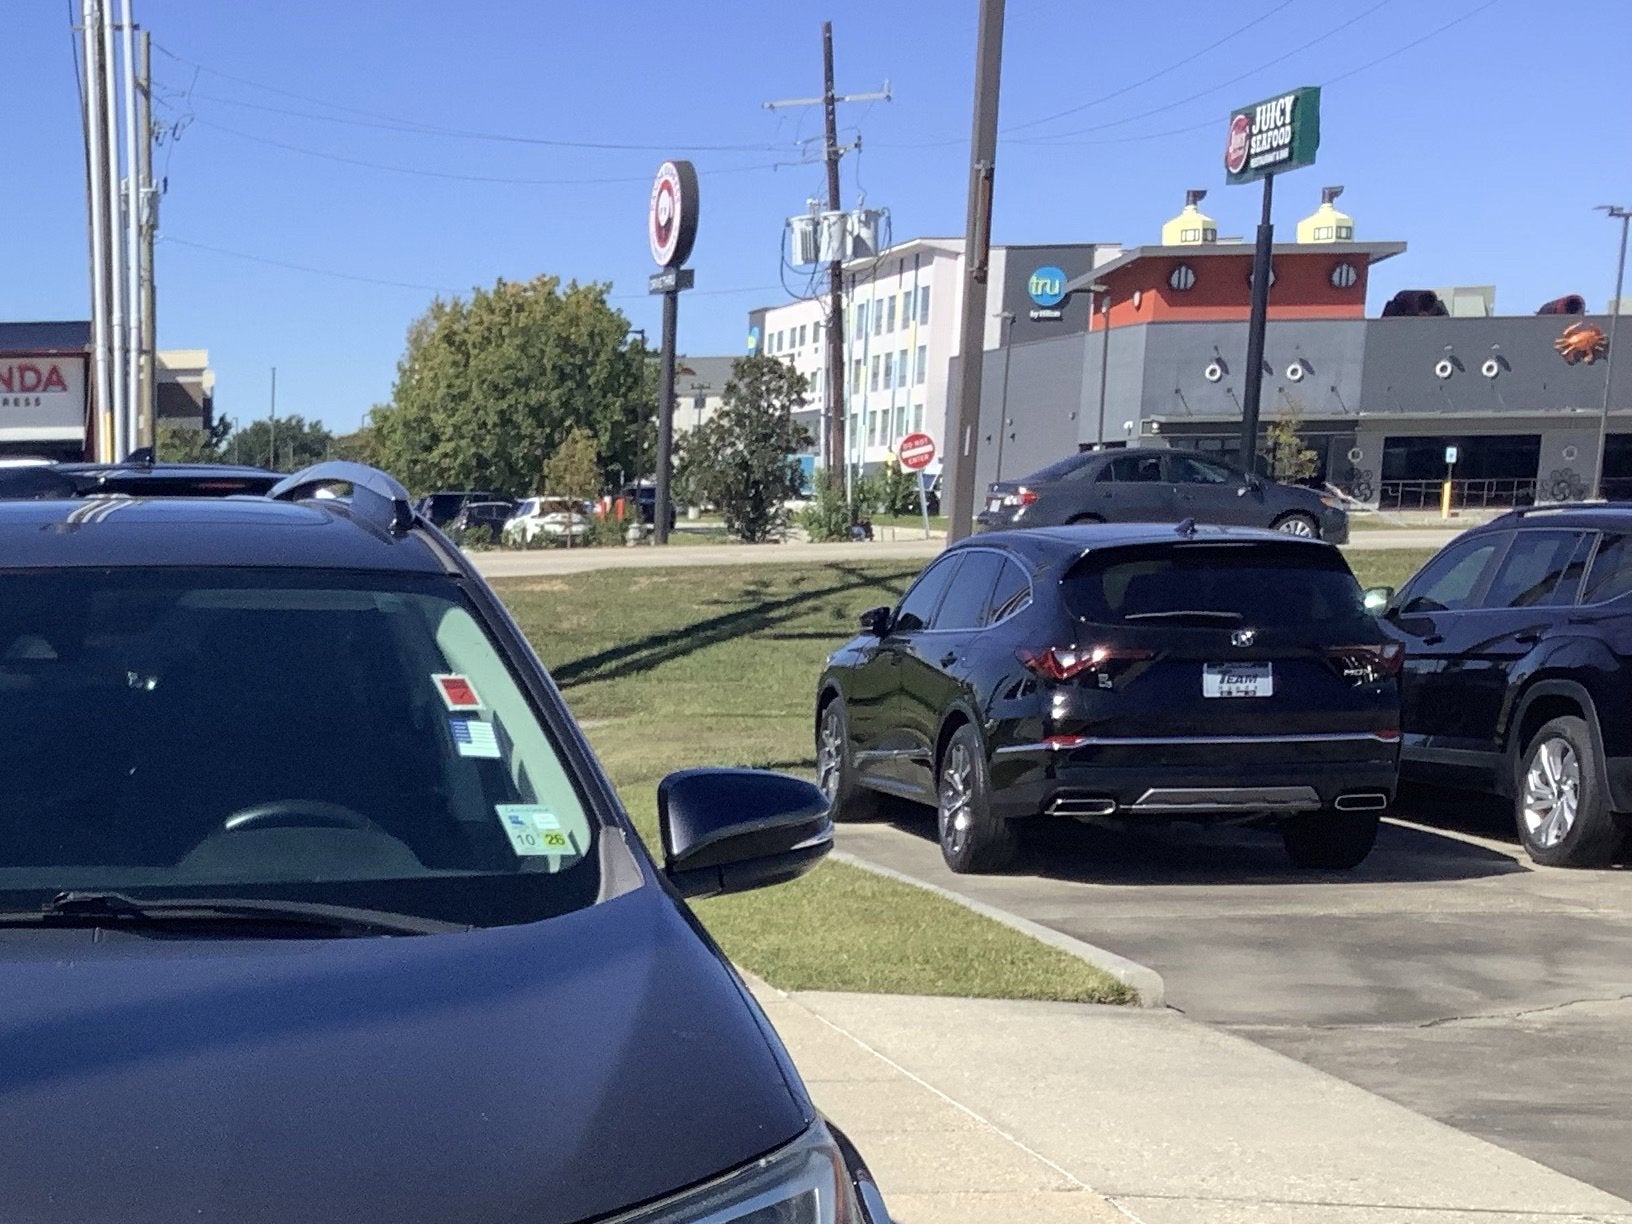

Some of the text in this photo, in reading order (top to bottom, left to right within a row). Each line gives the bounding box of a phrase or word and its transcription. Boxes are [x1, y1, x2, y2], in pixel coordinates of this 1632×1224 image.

[1252, 94, 1295, 134] JUICY
[1250, 125, 1292, 154] SEAFOOD
[1030, 273, 1060, 295] tru
[1217, 669, 1258, 684] TEAM
[517, 833, 566, 846] 10 26
